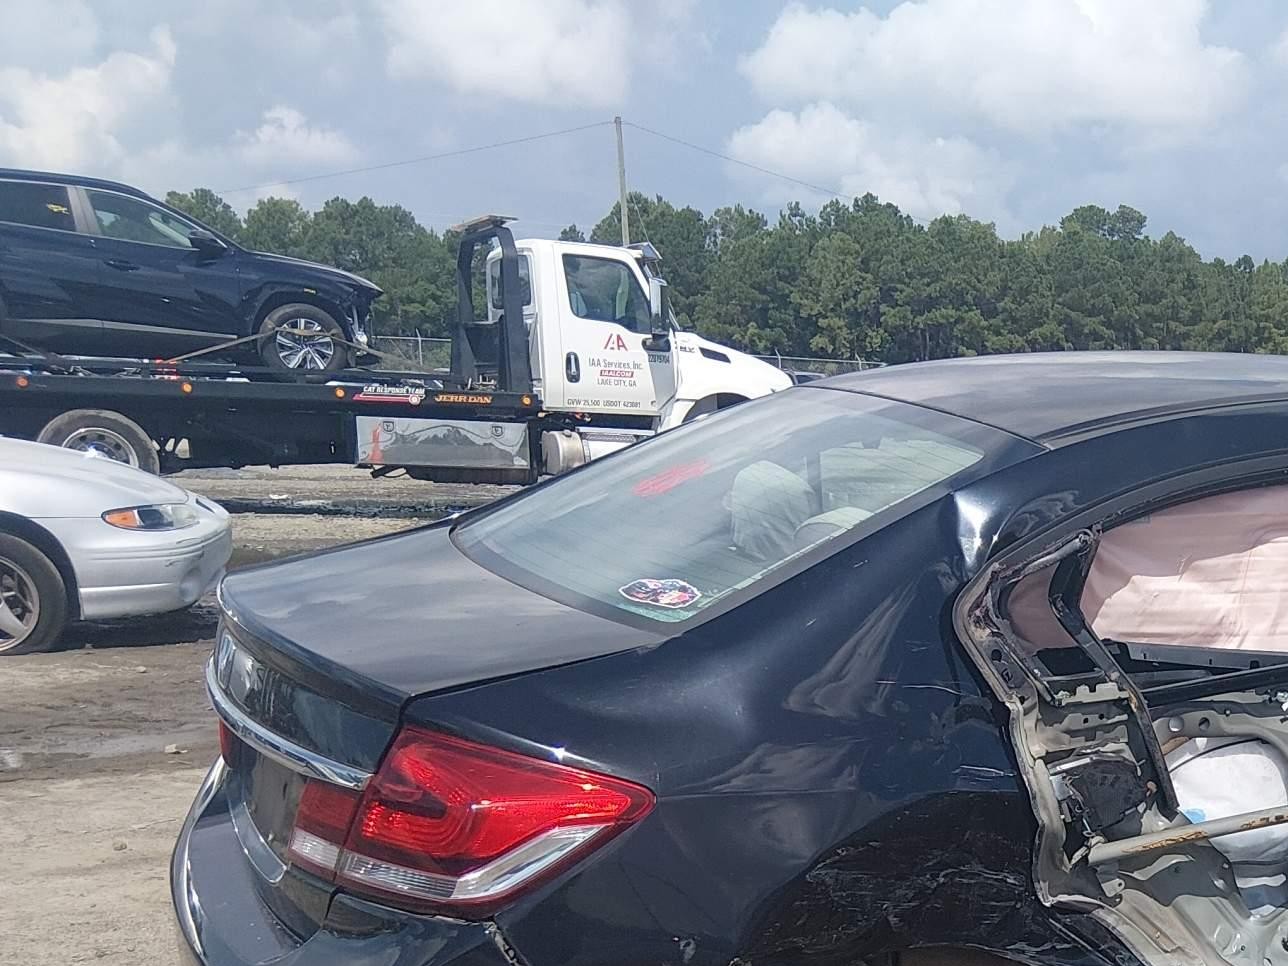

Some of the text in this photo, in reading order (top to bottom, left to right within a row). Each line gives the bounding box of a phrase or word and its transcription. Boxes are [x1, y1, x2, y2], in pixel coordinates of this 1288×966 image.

[588, 357, 602, 367] IAA
[597, 378, 612, 386] LAKE
[567, 398, 581, 406] GVW
